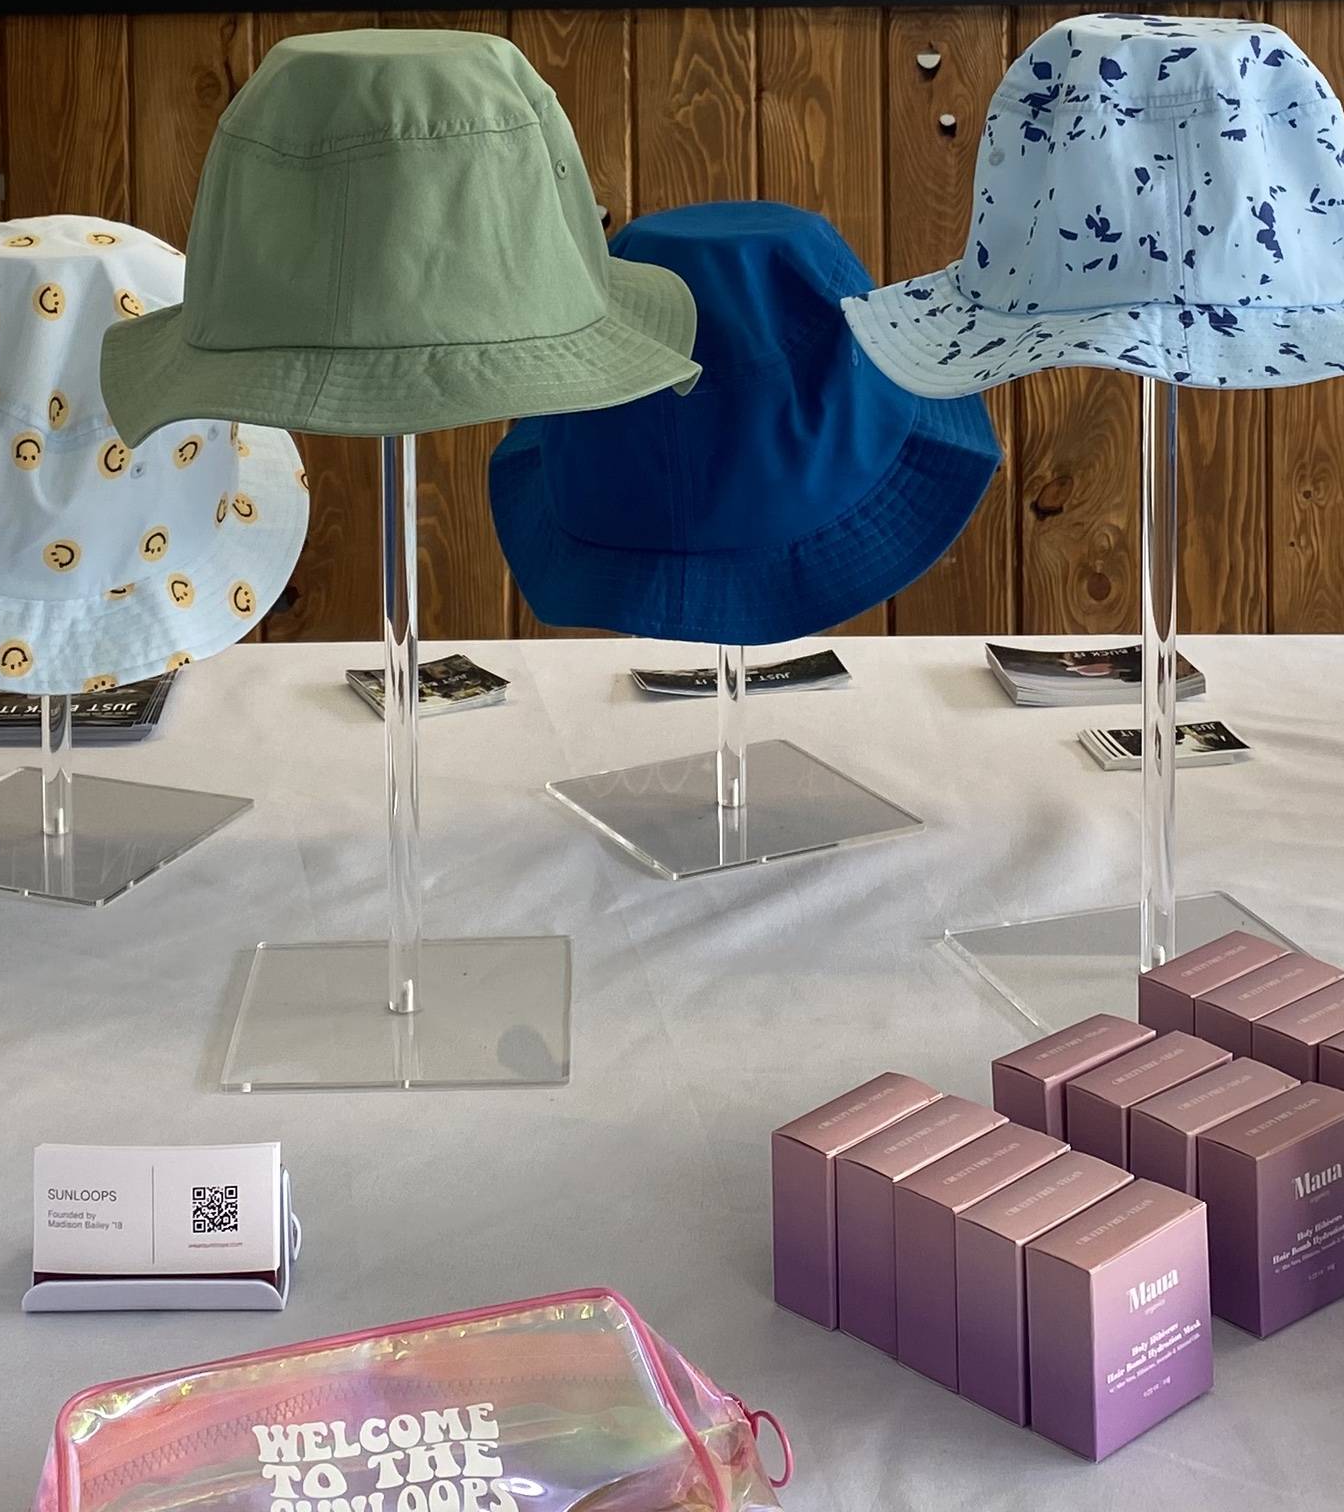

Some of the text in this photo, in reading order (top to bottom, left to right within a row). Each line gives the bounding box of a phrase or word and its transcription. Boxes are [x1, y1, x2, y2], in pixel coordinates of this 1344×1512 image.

[86, 701, 138, 714] JUST
[1292, 1163, 1343, 1201] Maua
[47, 1189, 117, 1202] SUNLOOPS
[47, 1210, 97, 1222] Founded by
[47, 1220, 83, 1229] Madison
[1126, 1269, 1179, 1313] Maua
[252, 1402, 499, 1463] WELCOME
[262, 1440, 504, 1498] TO THE
